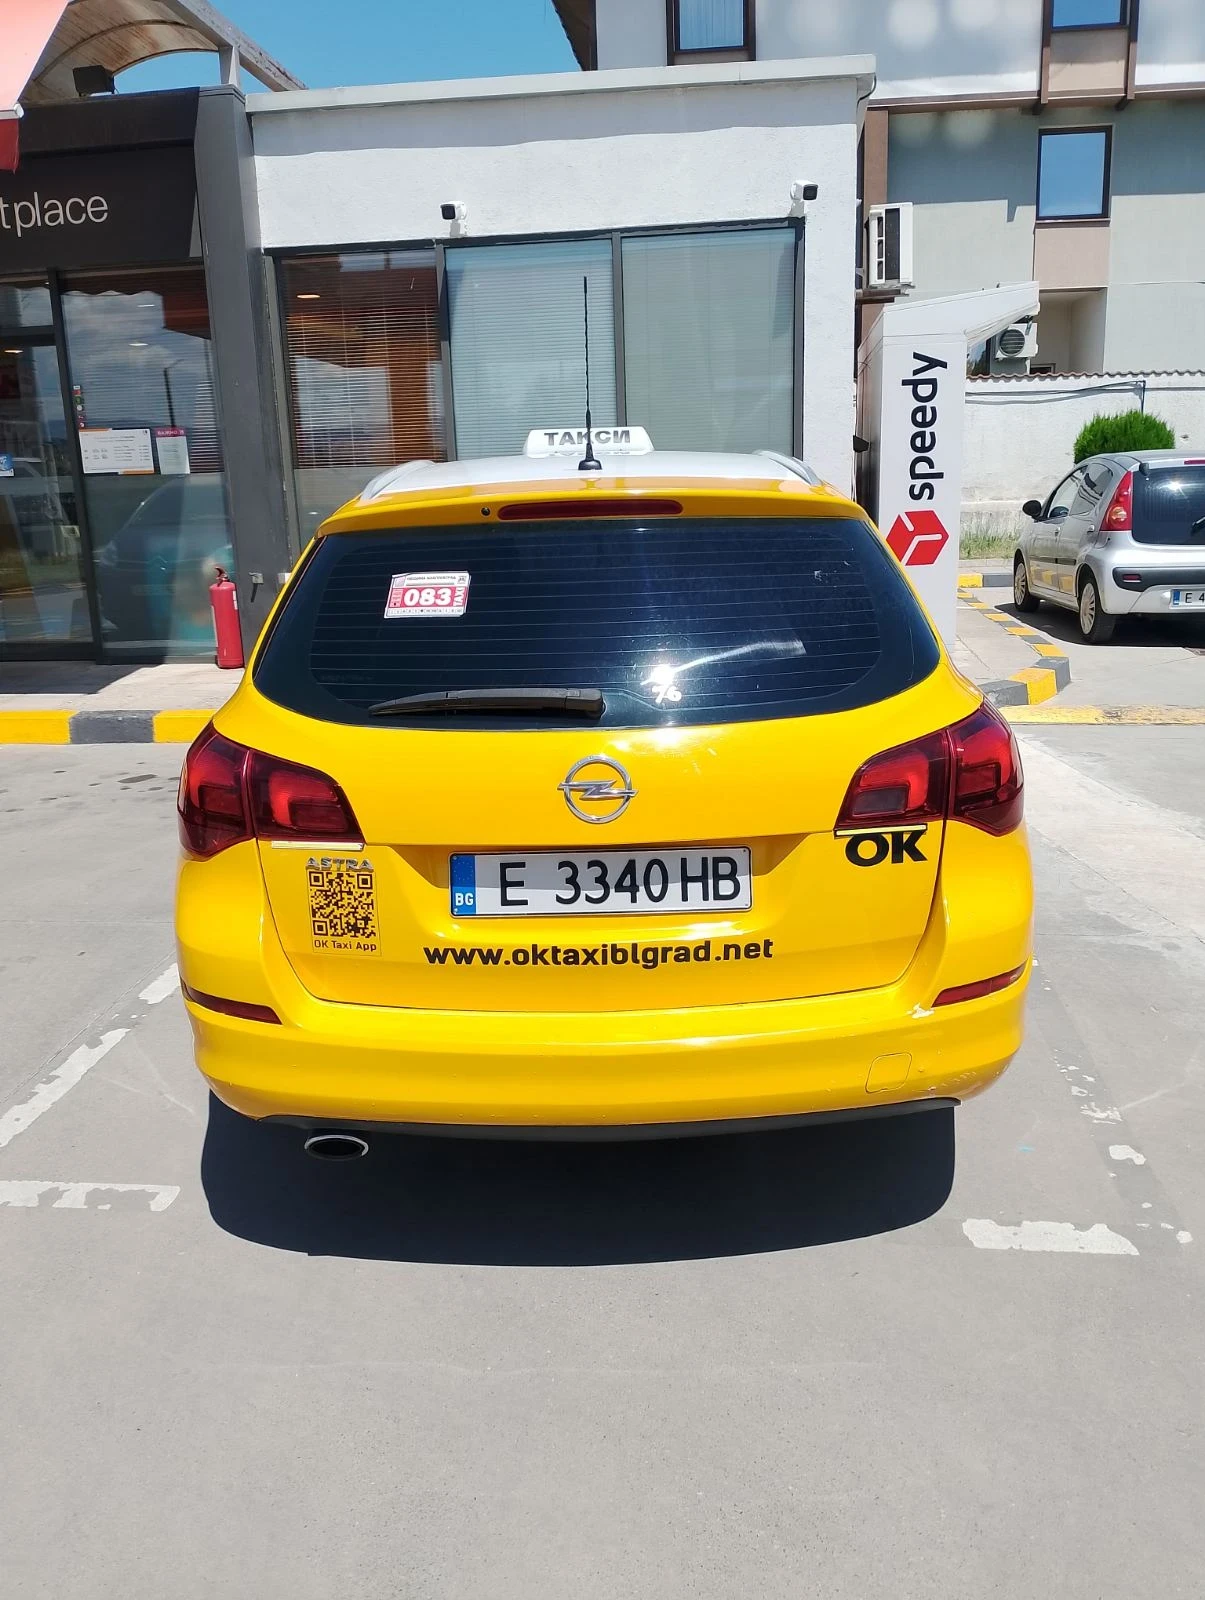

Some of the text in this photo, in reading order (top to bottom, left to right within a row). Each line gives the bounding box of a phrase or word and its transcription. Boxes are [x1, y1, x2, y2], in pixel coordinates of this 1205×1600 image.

[901, 352, 948, 500] speedy
[544, 430, 631, 446] ТАКСИ
[403, 588, 452, 606] 083
[1185, 593, 1192, 603] E
[845, 830, 928, 867] OK
[306, 857, 374, 871] ASTRA
[500, 861, 529, 906] E
[555, 858, 669, 904] 3340
[455, 892, 473, 905] BG
[314, 939, 377, 952] OK Taxi App
[424, 938, 773, 968] www.oktaxiblgrad.net
